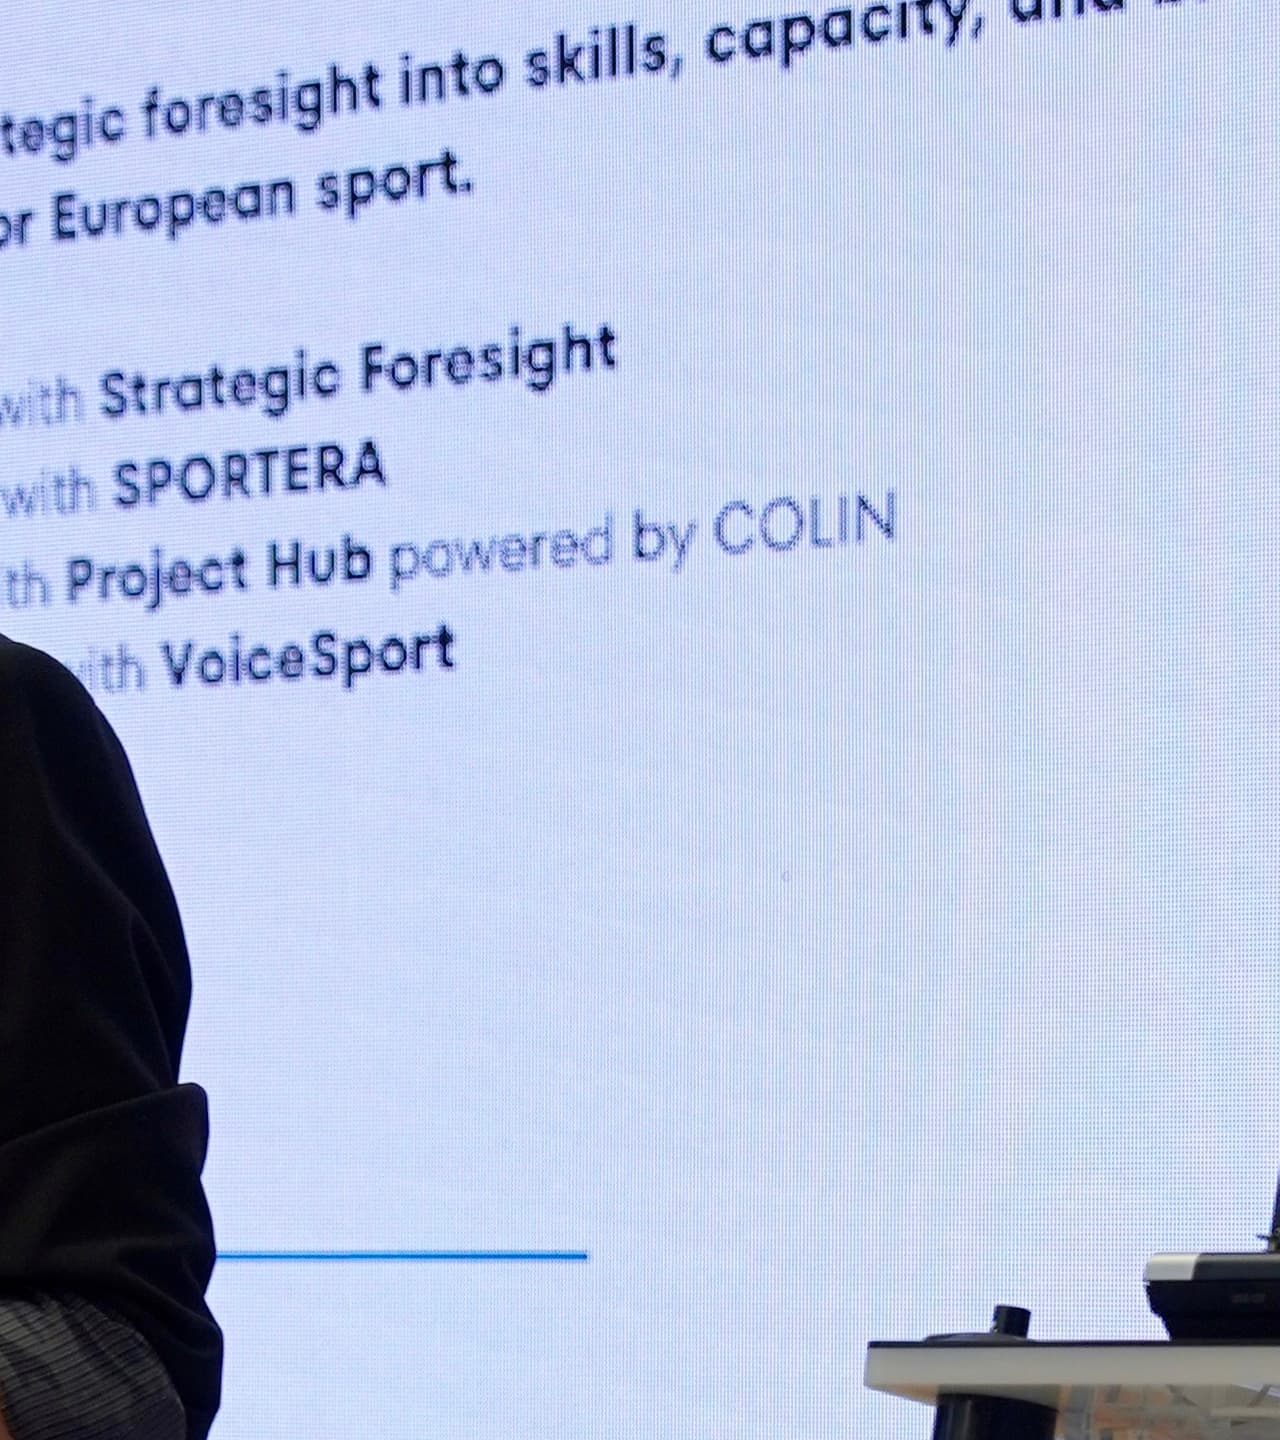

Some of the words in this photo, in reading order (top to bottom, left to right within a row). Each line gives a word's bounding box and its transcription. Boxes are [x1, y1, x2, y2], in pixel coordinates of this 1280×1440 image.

[144, 65, 381, 133] foresight
[398, 44, 504, 104] into
[527, 24, 683, 87] skills,
[54, 174, 296, 243] European
[318, 151, 474, 212] sport.
[101, 351, 341, 421] Strategic
[359, 325, 617, 393] Foresight
[0, 469, 97, 516] with
[113, 440, 386, 507] SPORTERA
[68, 542, 245, 610] Project
[265, 536, 372, 588] Hub
[389, 510, 614, 594] powered
[633, 507, 697, 573] by
[714, 490, 896, 555] COLIN
[75, 642, 145, 695] ith
[160, 622, 454, 687] VoiceSport
